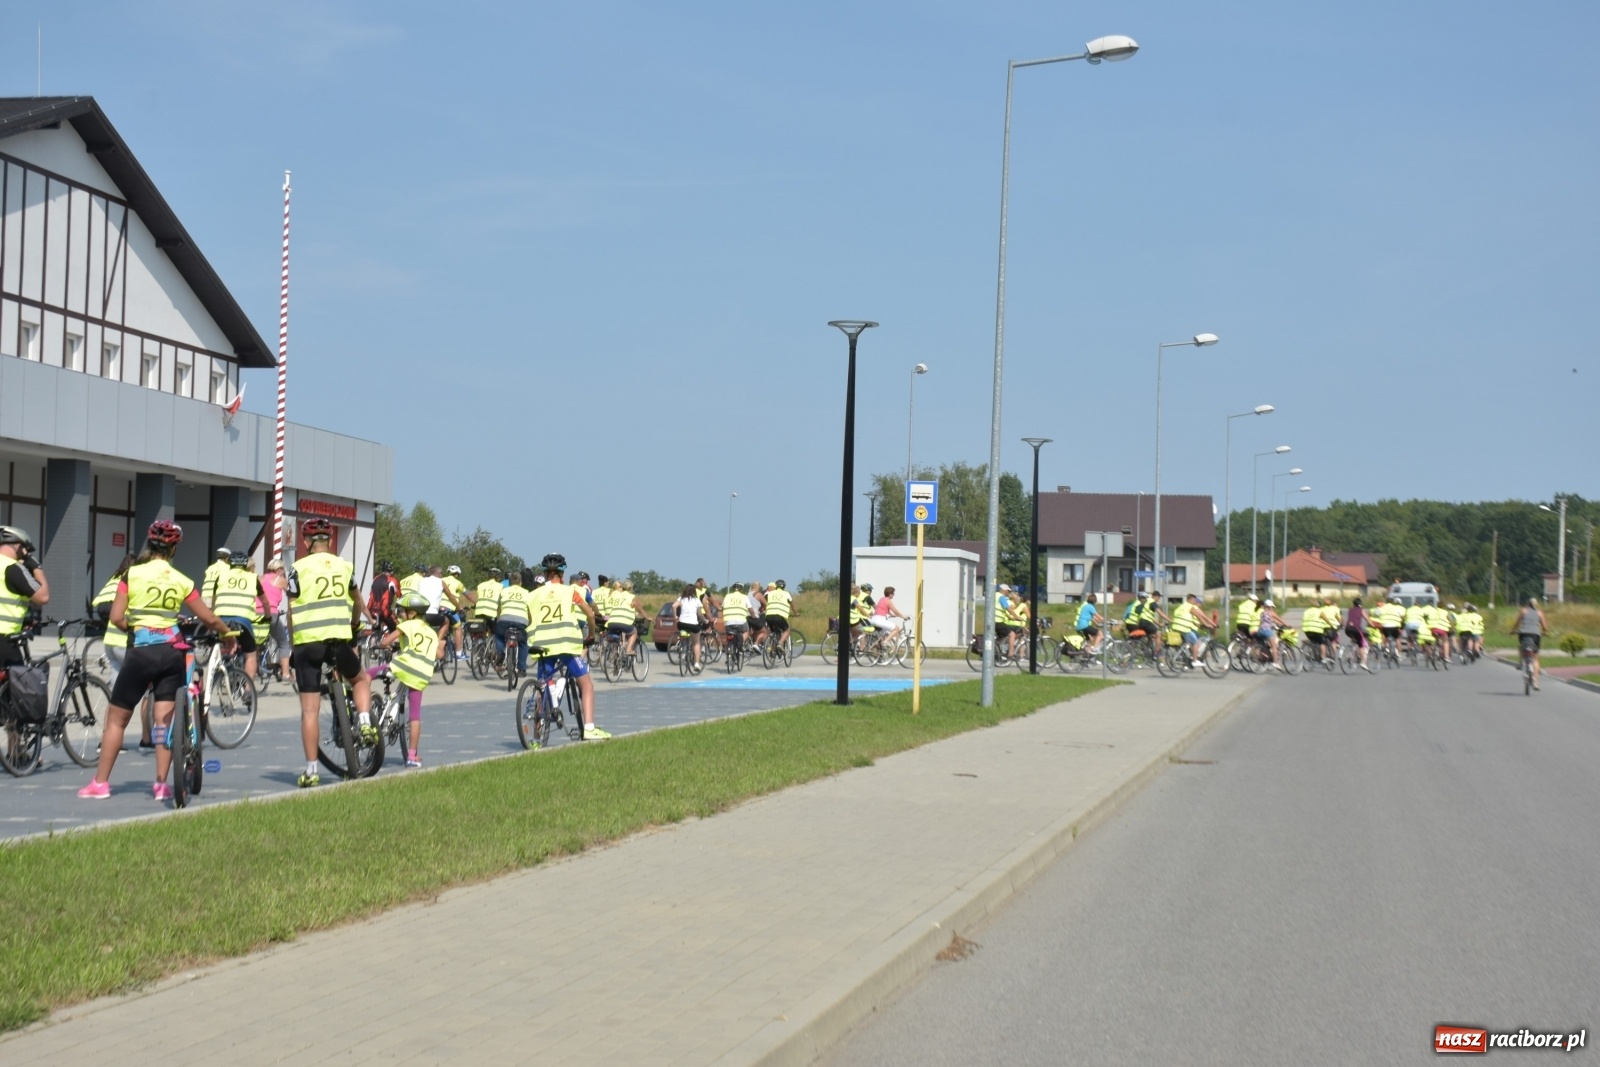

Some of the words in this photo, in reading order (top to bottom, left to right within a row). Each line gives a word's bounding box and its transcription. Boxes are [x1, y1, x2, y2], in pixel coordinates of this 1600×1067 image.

[227, 577, 248, 590] 90
[315, 574, 345, 600] 25
[482, 588, 494, 599] 13
[143, 586, 178, 610] 26
[508, 591, 523, 600] 28
[540, 603, 564, 623] 24
[414, 632, 433, 655] 27
